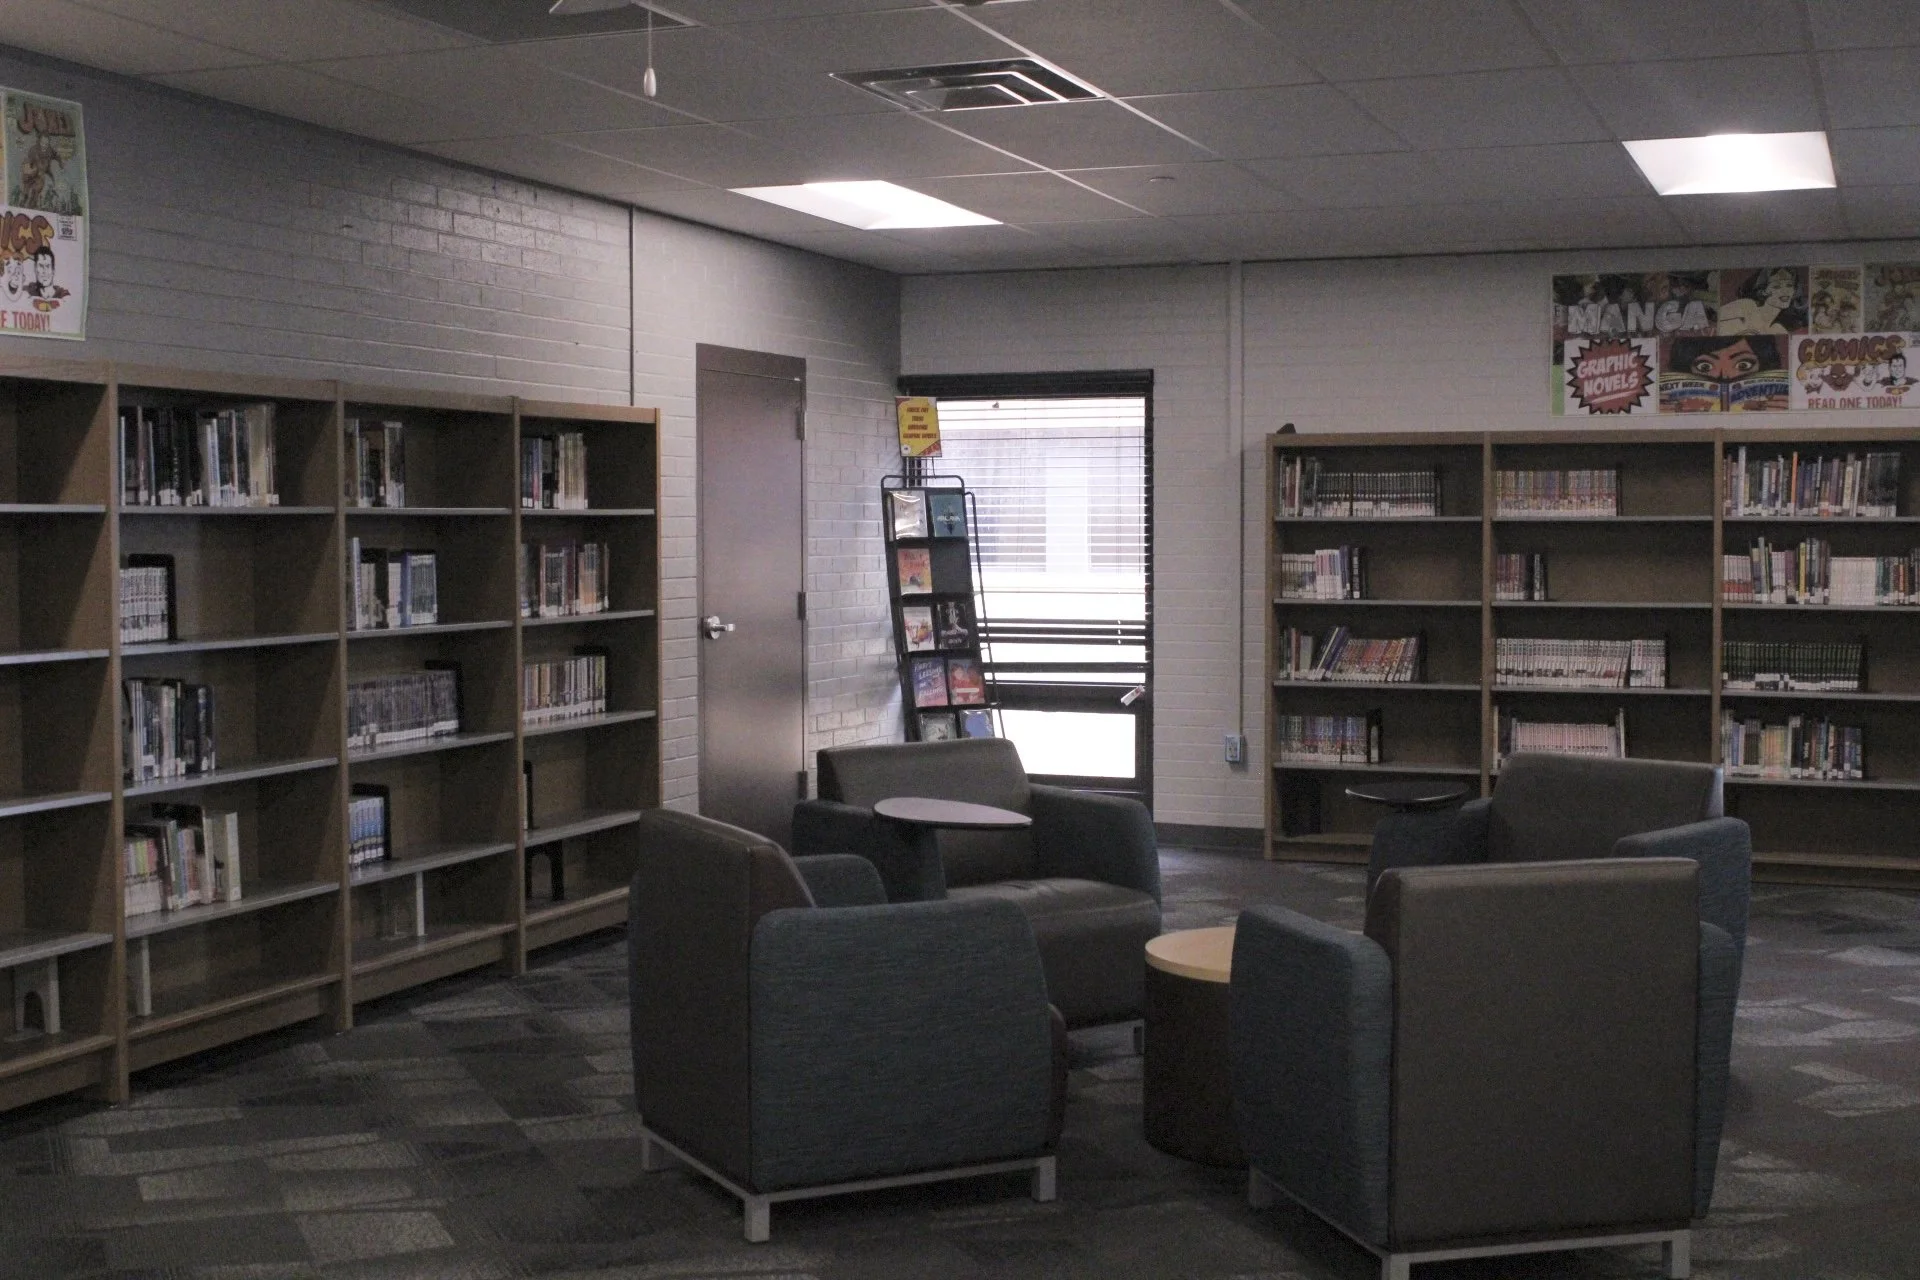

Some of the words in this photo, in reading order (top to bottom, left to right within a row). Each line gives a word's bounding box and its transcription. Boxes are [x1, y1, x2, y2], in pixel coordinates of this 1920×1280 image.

[0, 211, 51, 256] ICS
[12, 311, 51, 332] TODAY!
[1568, 300, 1710, 334] MANGA
[1798, 335, 1905, 364] COMICS
[1576, 352, 1638, 378] GRAPHIC
[1583, 371, 1639, 397] NOVELS
[1660, 382, 1679, 392] NEXT
[1808, 397, 1836, 409] READ
[1839, 396, 1861, 409] ONE
[1866, 395, 1902, 409] TODAY!
